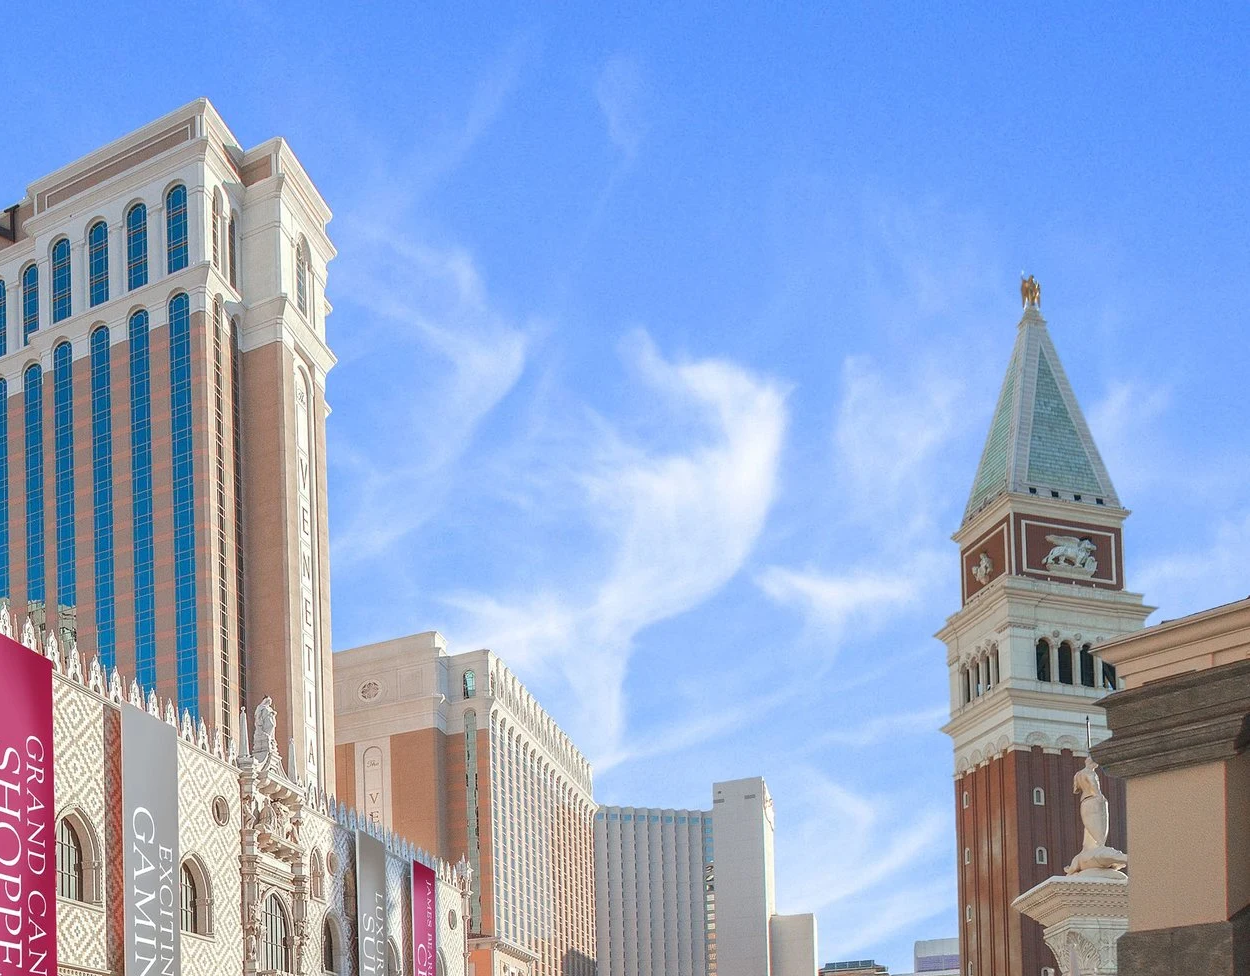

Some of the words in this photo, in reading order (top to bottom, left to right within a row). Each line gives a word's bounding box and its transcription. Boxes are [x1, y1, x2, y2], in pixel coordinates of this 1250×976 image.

[299, 457, 316, 767] VENETIA
[25, 735, 45, 877] GRAND
[424, 879, 432, 929] JAMES
